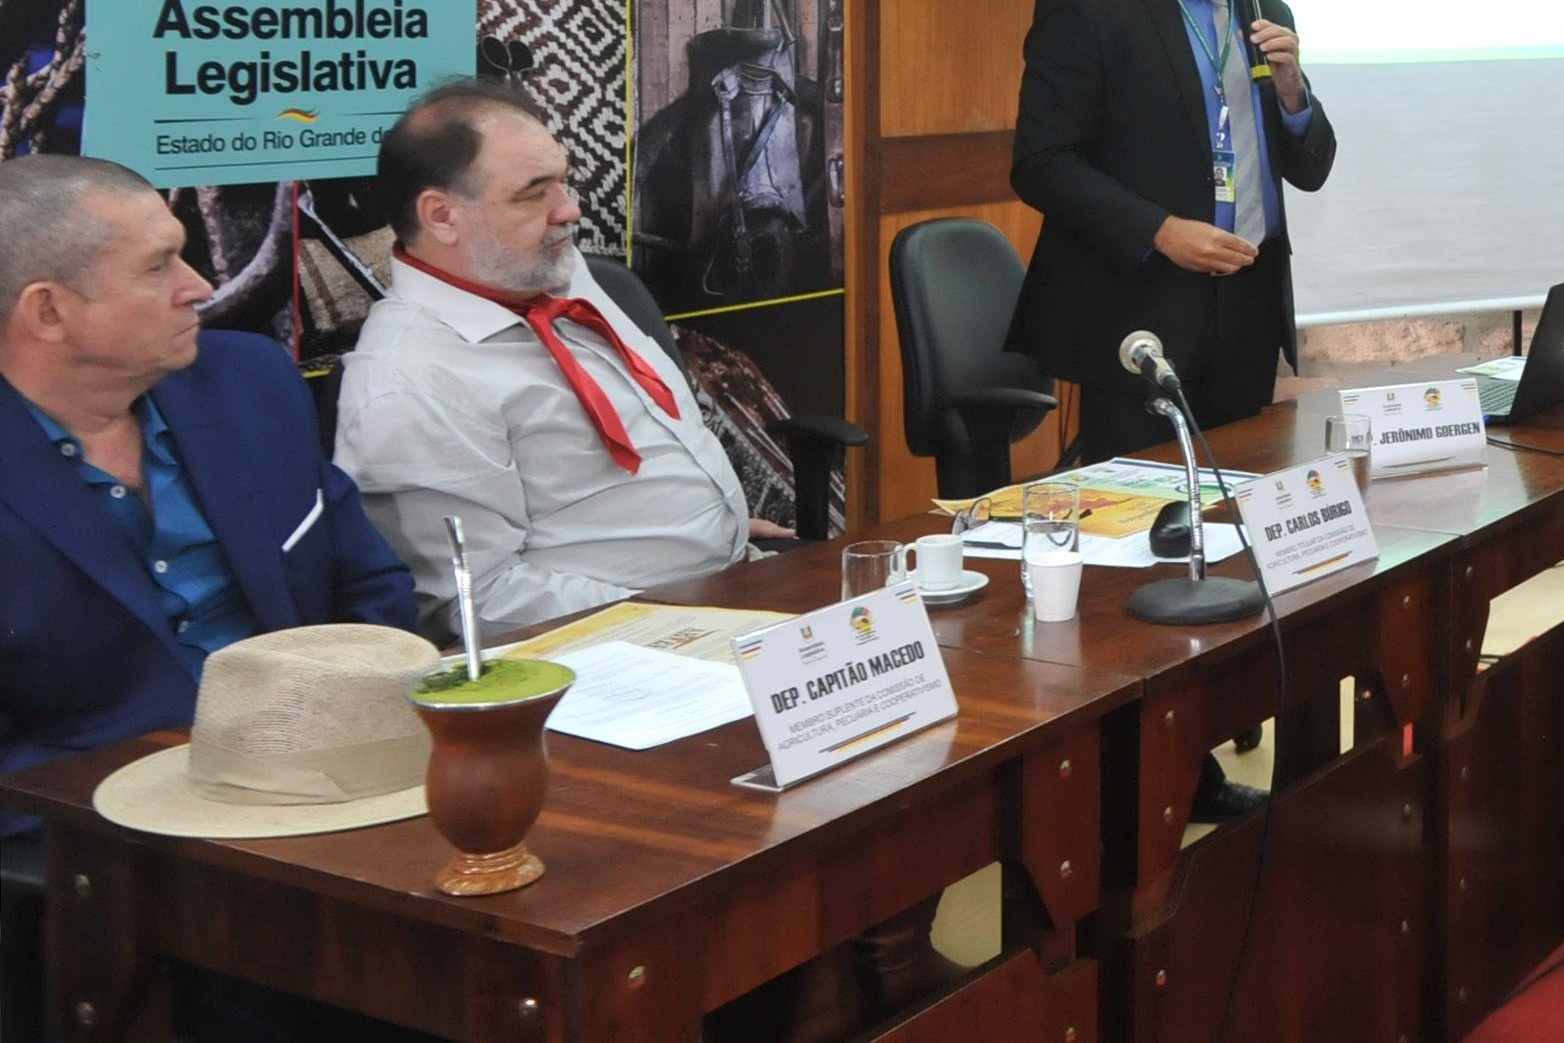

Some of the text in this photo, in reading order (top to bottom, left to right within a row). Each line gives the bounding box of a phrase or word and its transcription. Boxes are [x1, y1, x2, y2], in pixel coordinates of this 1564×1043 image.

[165, 50, 417, 105] Legislativa
[156, 126, 388, 154] Estado do Rio Grande d
[1380, 426, 1434, 445] JERÔNIMO
[1436, 421, 1481, 439] GOERGEN
[1264, 523, 1287, 541] DEP.
[1285, 510, 1321, 534] CARLOS
[770, 686, 807, 714] DEP.
[806, 662, 868, 701] CAPITÃO
[867, 640, 925, 678] MACEDO
